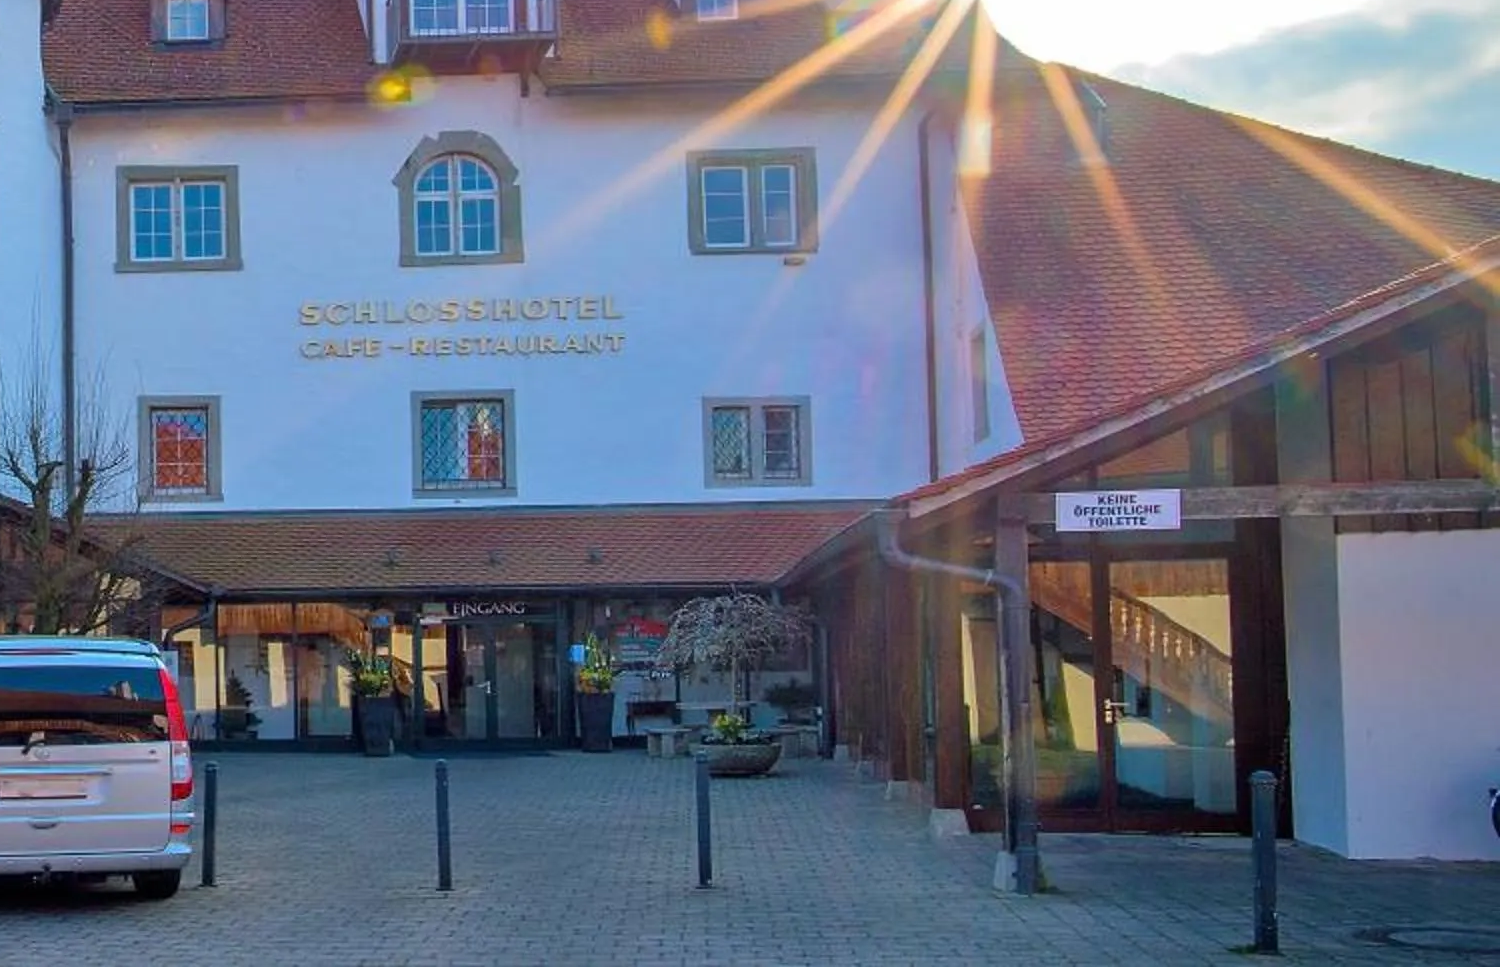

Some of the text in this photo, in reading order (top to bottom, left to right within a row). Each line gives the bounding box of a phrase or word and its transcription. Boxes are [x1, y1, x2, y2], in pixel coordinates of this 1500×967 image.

[300, 295, 624, 325] SCHLOSSHOTEL
[1097, 494, 1137, 505] KEINE
[1073, 504, 1162, 518] ÖFFENTLICHE
[1088, 516, 1148, 528] TOILETTE
[453, 601, 526, 616] EINGANG
